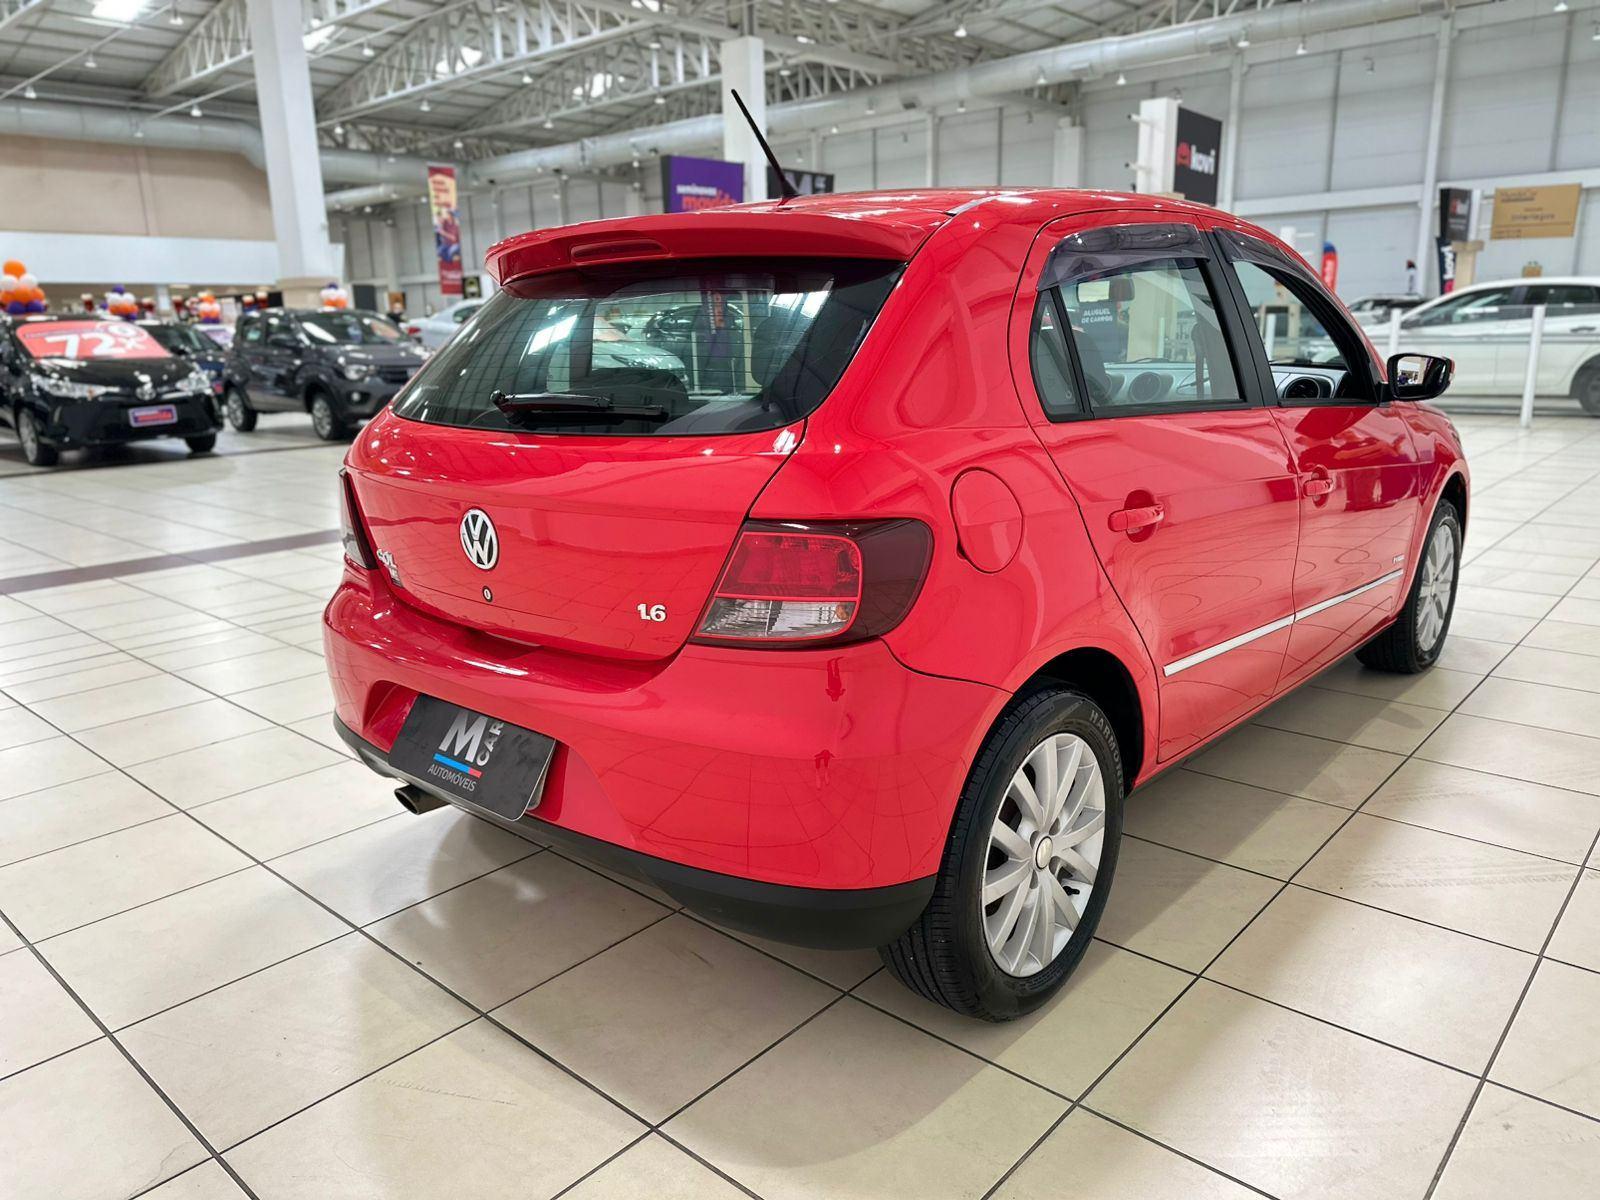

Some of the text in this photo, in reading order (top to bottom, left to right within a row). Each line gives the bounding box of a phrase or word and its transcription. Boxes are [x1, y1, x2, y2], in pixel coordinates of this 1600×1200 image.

[637, 603, 666, 622] 1.6
[476, 721, 505, 767] CAR
[427, 763, 477, 792] AUTOMÓVEIS
